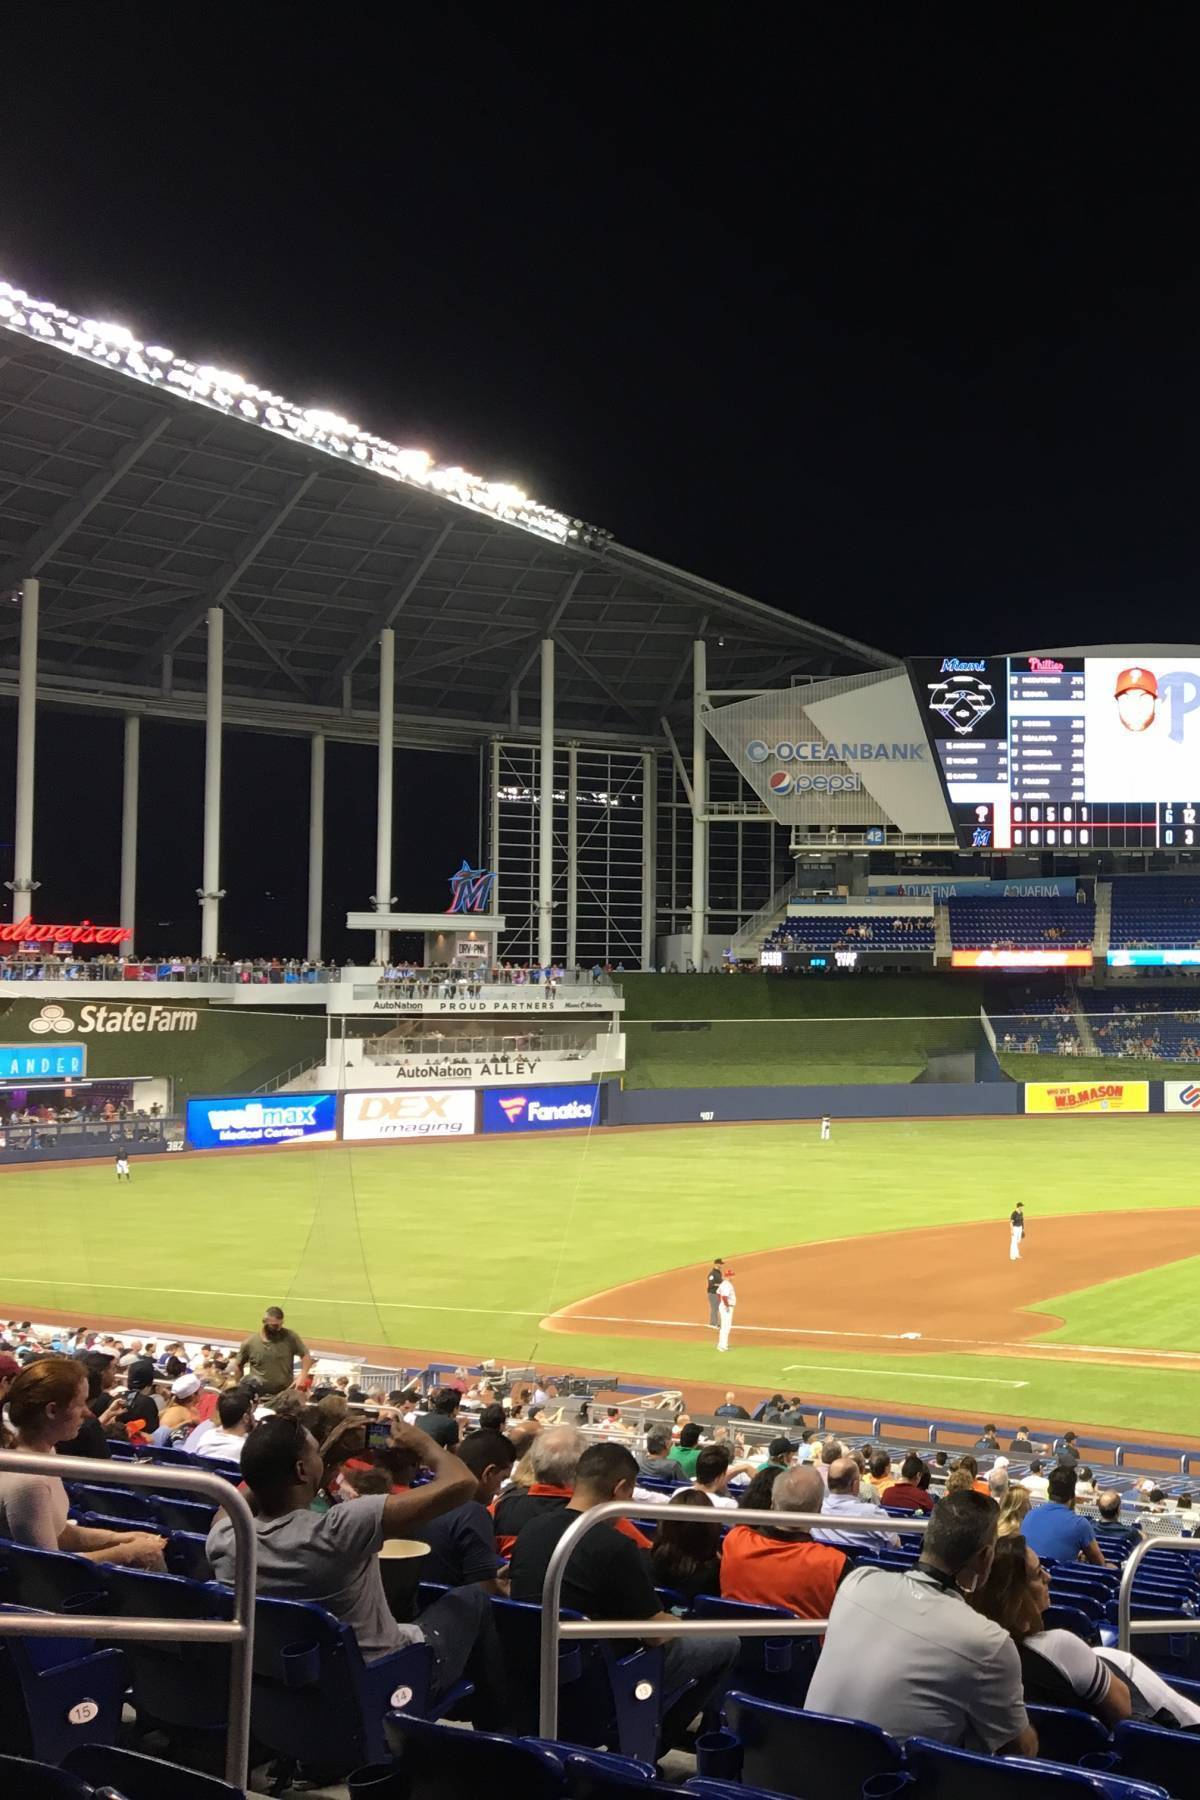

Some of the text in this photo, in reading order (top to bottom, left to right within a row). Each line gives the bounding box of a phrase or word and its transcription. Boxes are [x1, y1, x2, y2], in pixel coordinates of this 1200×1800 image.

[940, 659, 986, 672] Miami
[1028, 657, 1064, 672] Phillies
[776, 741, 925, 761] OCEANBANK
[795, 772, 861, 794] pepsi
[867, 832, 882, 842] 42
[373, 1001, 423, 1011] AutoNation
[440, 1002, 487, 1010] PROUD
[494, 1001, 555, 1010] PARTNERS
[10, 1058, 79, 1074] ANDER
[396, 1063, 537, 1079] AutoNation ALLEY
[357, 1095, 450, 1121] DEX
[528, 1101, 592, 1122] Fanatics
[379, 1121, 463, 1135] imaging
[75, 1705, 91, 1720] 15
